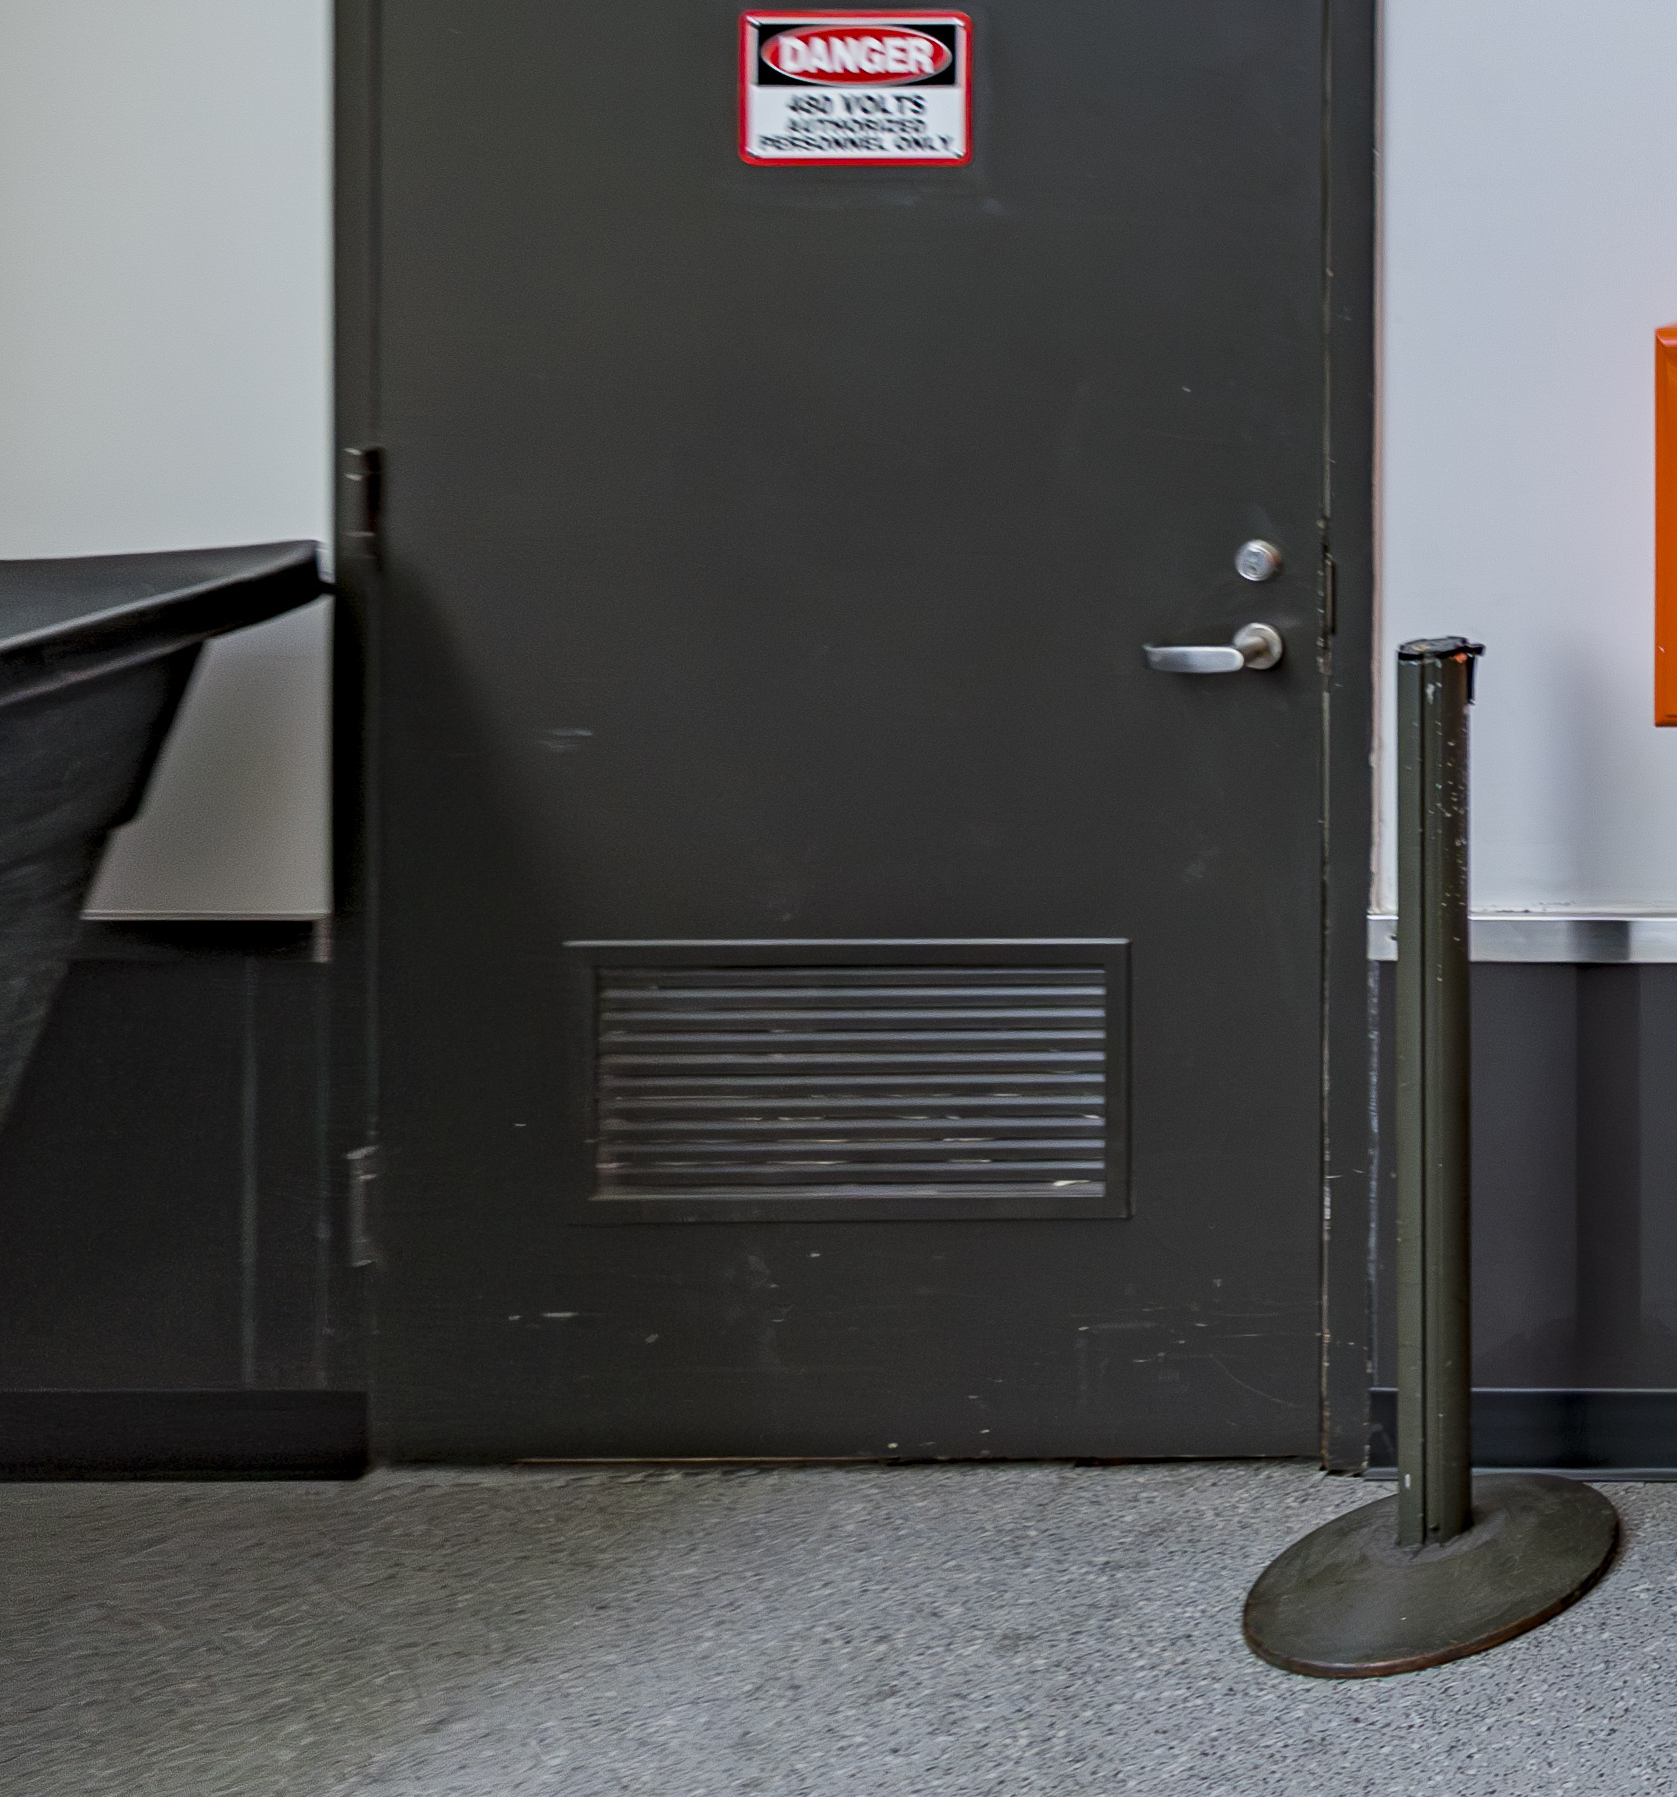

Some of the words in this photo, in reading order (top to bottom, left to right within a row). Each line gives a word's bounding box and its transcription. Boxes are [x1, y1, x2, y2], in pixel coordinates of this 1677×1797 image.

[777, 35, 936, 74] DANGER
[841, 94, 926, 115] VOLTS
[759, 134, 885, 151] PERSONNEL
[894, 135, 953, 151] ONLY
